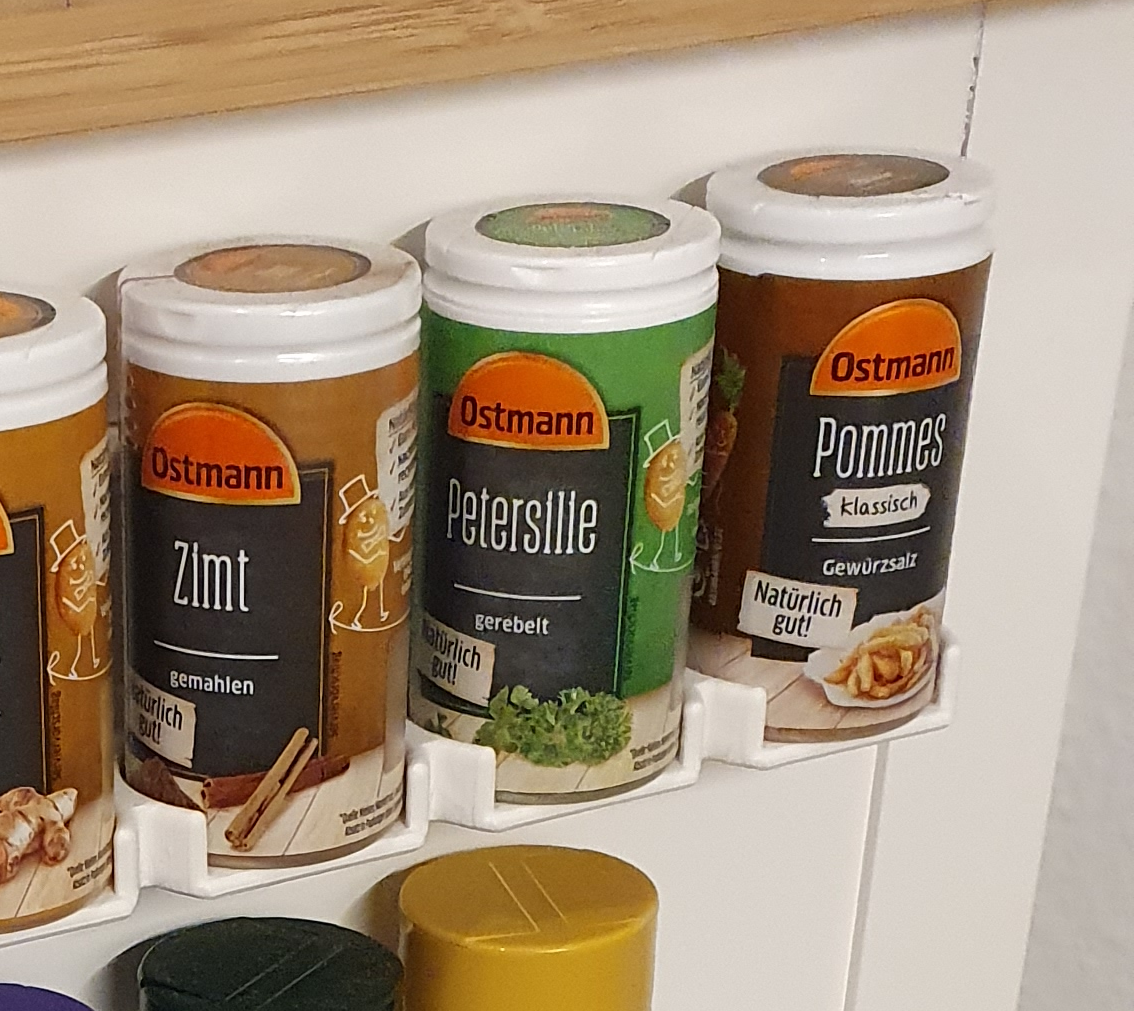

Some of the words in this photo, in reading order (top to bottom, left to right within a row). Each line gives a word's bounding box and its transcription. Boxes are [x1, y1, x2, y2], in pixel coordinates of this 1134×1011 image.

[831, 346, 955, 383] Ostmann
[461, 396, 595, 436] Ostmann
[813, 413, 947, 478] Pommes
[151, 446, 284, 491] Ostmann
[446, 478, 598, 555] Petersilie
[173, 540, 250, 612] Zimt
[822, 552, 918, 577] Gewürzsalz
[754, 580, 842, 618] Natürlich
[475, 613, 550, 636] gerebelt
[772, 614, 811, 639] gut!
[170, 670, 255, 696] gemahlen
